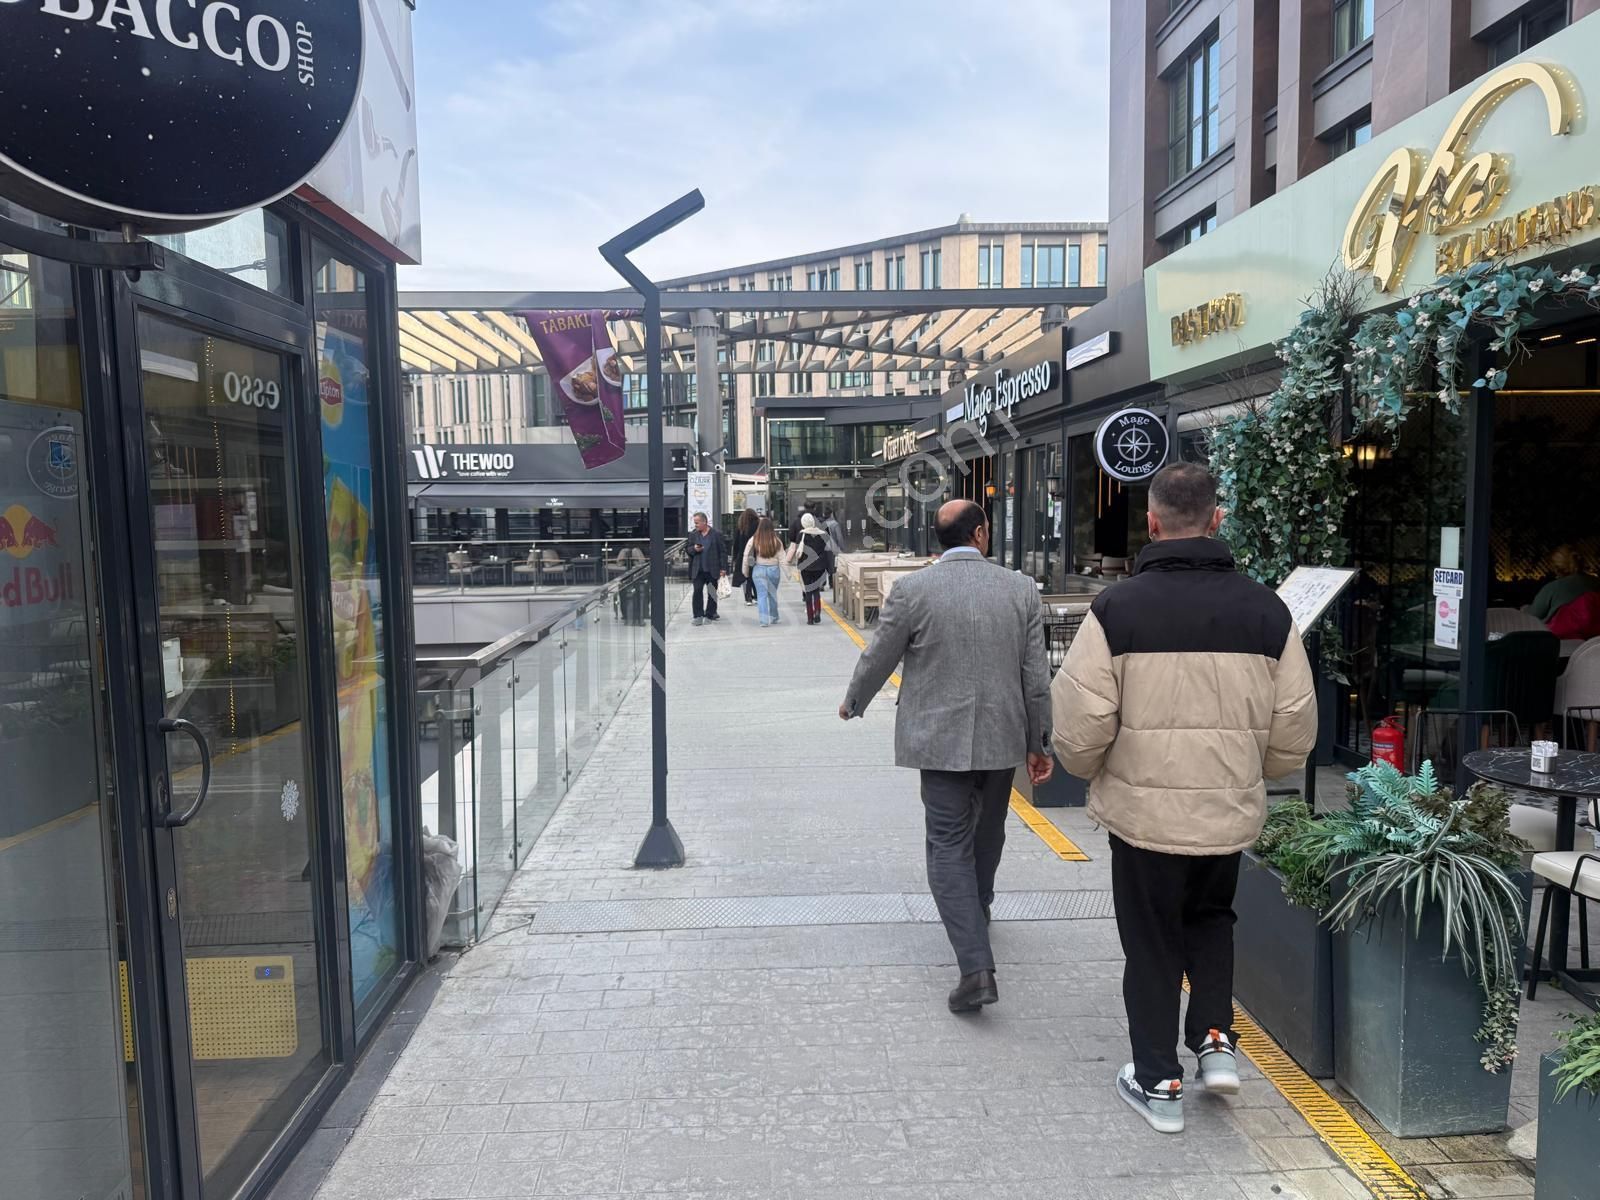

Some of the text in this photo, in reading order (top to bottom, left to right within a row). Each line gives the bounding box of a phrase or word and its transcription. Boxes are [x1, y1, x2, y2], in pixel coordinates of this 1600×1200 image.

[295, 21, 315, 87] SHOP
[963, 360, 1050, 437] Mage Espresso
[1118, 415, 1150, 427] Mage
[450, 453, 514, 470] THEWOO
[1114, 460, 1154, 474] Lounge
[25, 562, 74, 605] Bull
[1434, 569, 1464, 585] SETCARD
